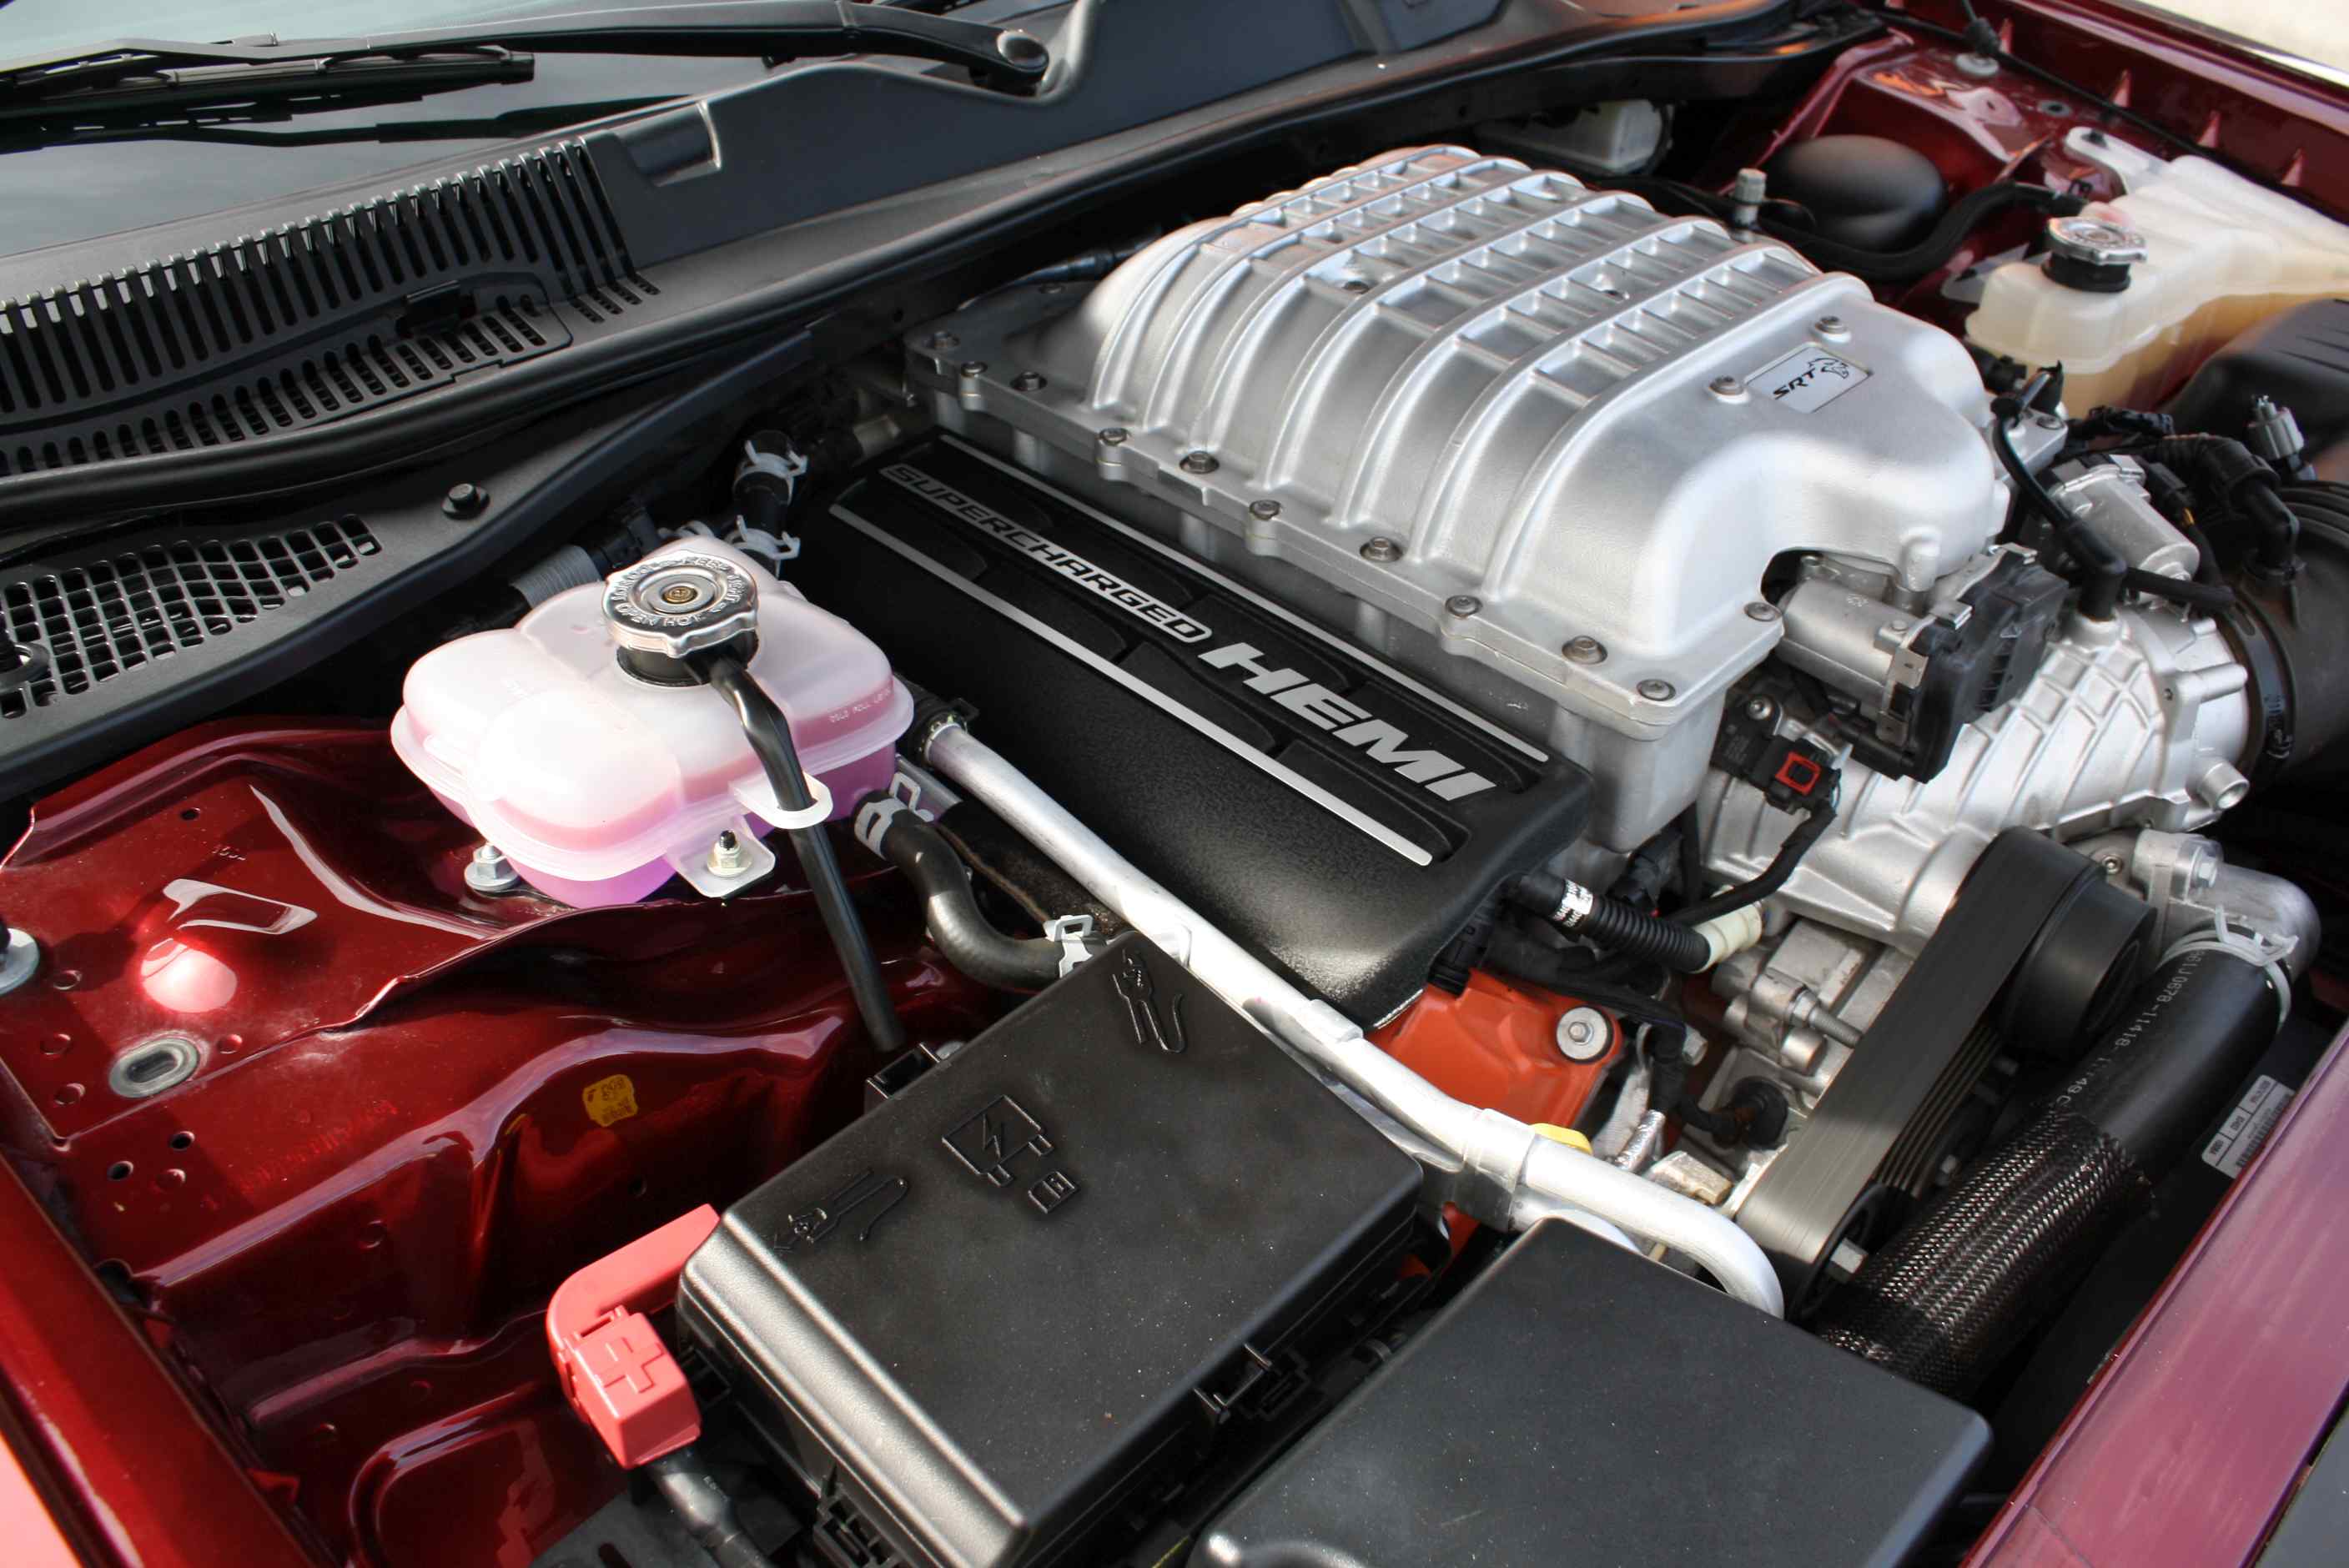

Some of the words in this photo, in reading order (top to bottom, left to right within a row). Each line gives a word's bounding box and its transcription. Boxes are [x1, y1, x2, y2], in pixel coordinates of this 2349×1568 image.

[1773, 368, 1816, 400] SRT
[888, 465, 1207, 640] SUPERCHARGED
[615, 603, 660, 626] OPEN
[1197, 642, 1497, 801] HEMI
